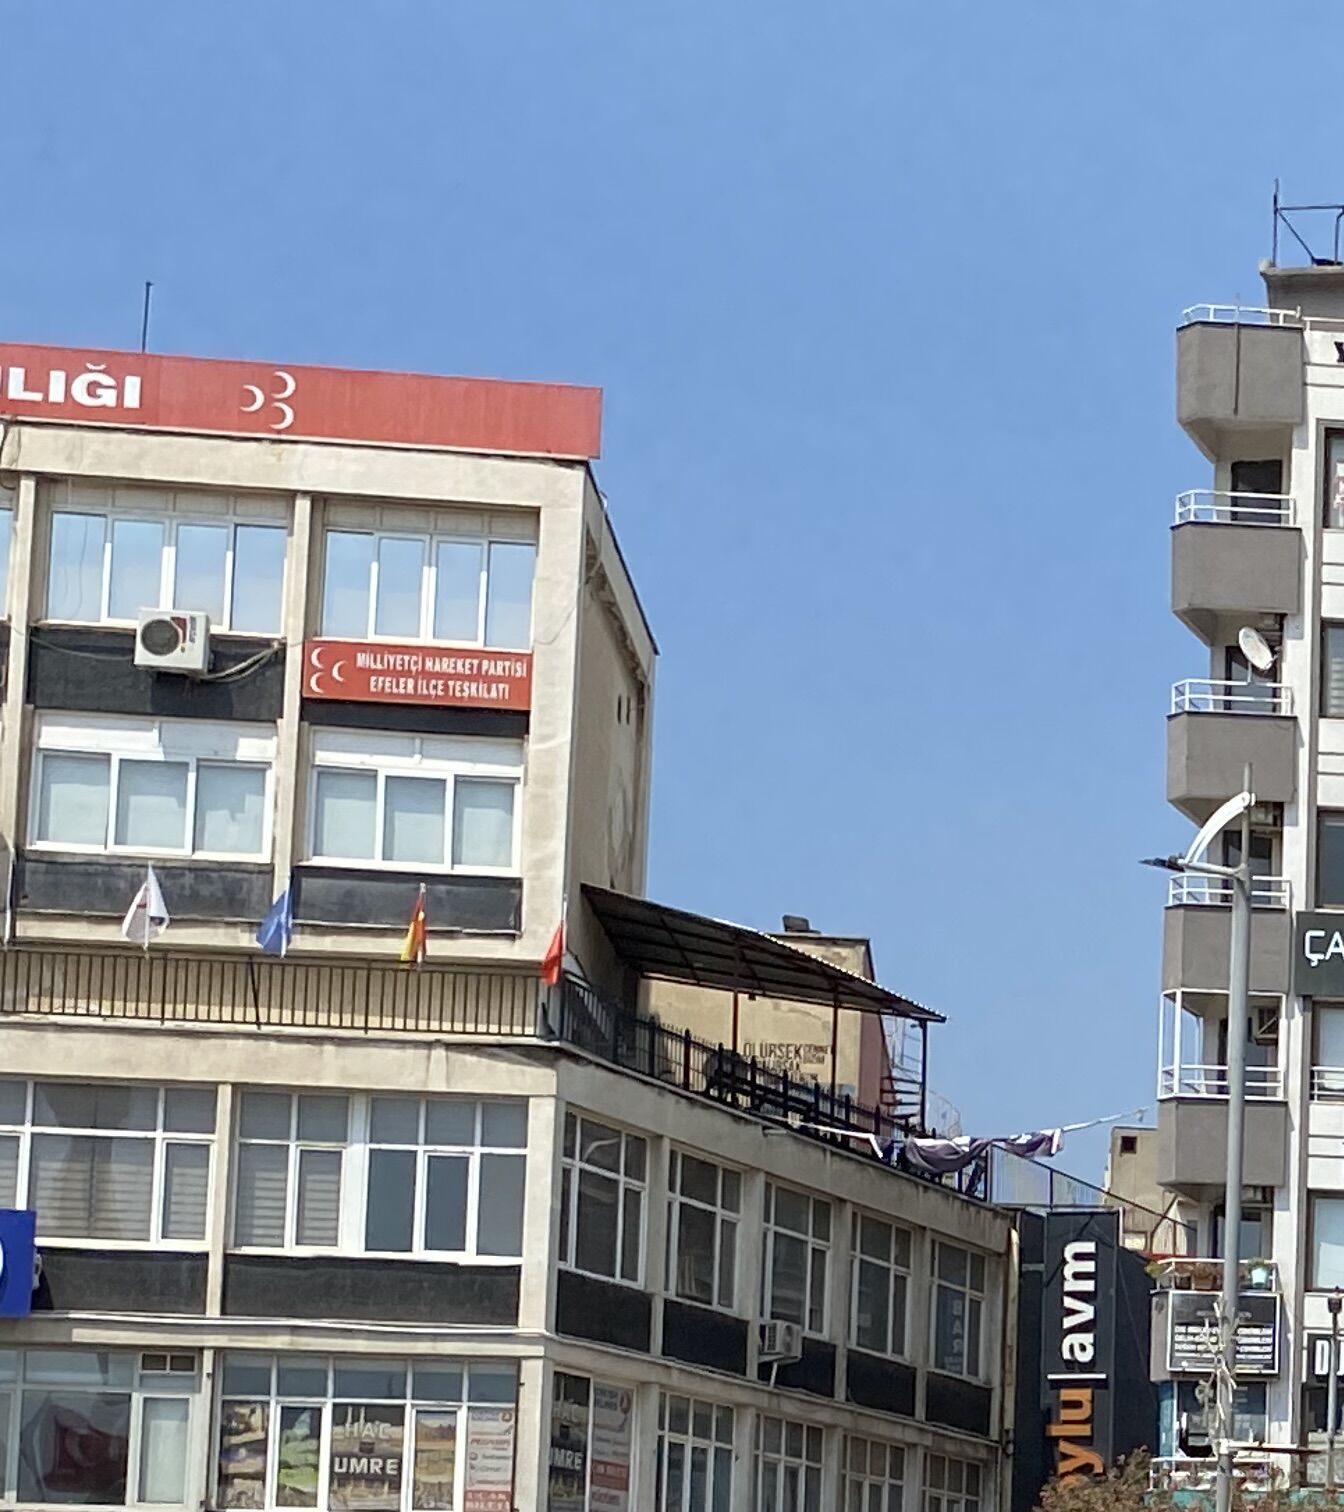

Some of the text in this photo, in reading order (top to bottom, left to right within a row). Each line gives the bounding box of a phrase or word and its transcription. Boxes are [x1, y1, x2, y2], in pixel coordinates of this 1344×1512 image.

[0, 362, 141, 409] LIĞI
[356, 652, 527, 678] MİLLİYETÇİ HAREKET PARTİSİ
[369, 676, 509, 700] EFELER İLÇE TEŞKİLATI
[1060, 1241, 1097, 1364] avm
[345, 1422, 391, 1439] HAC
[334, 1456, 399, 1475] UMRE
